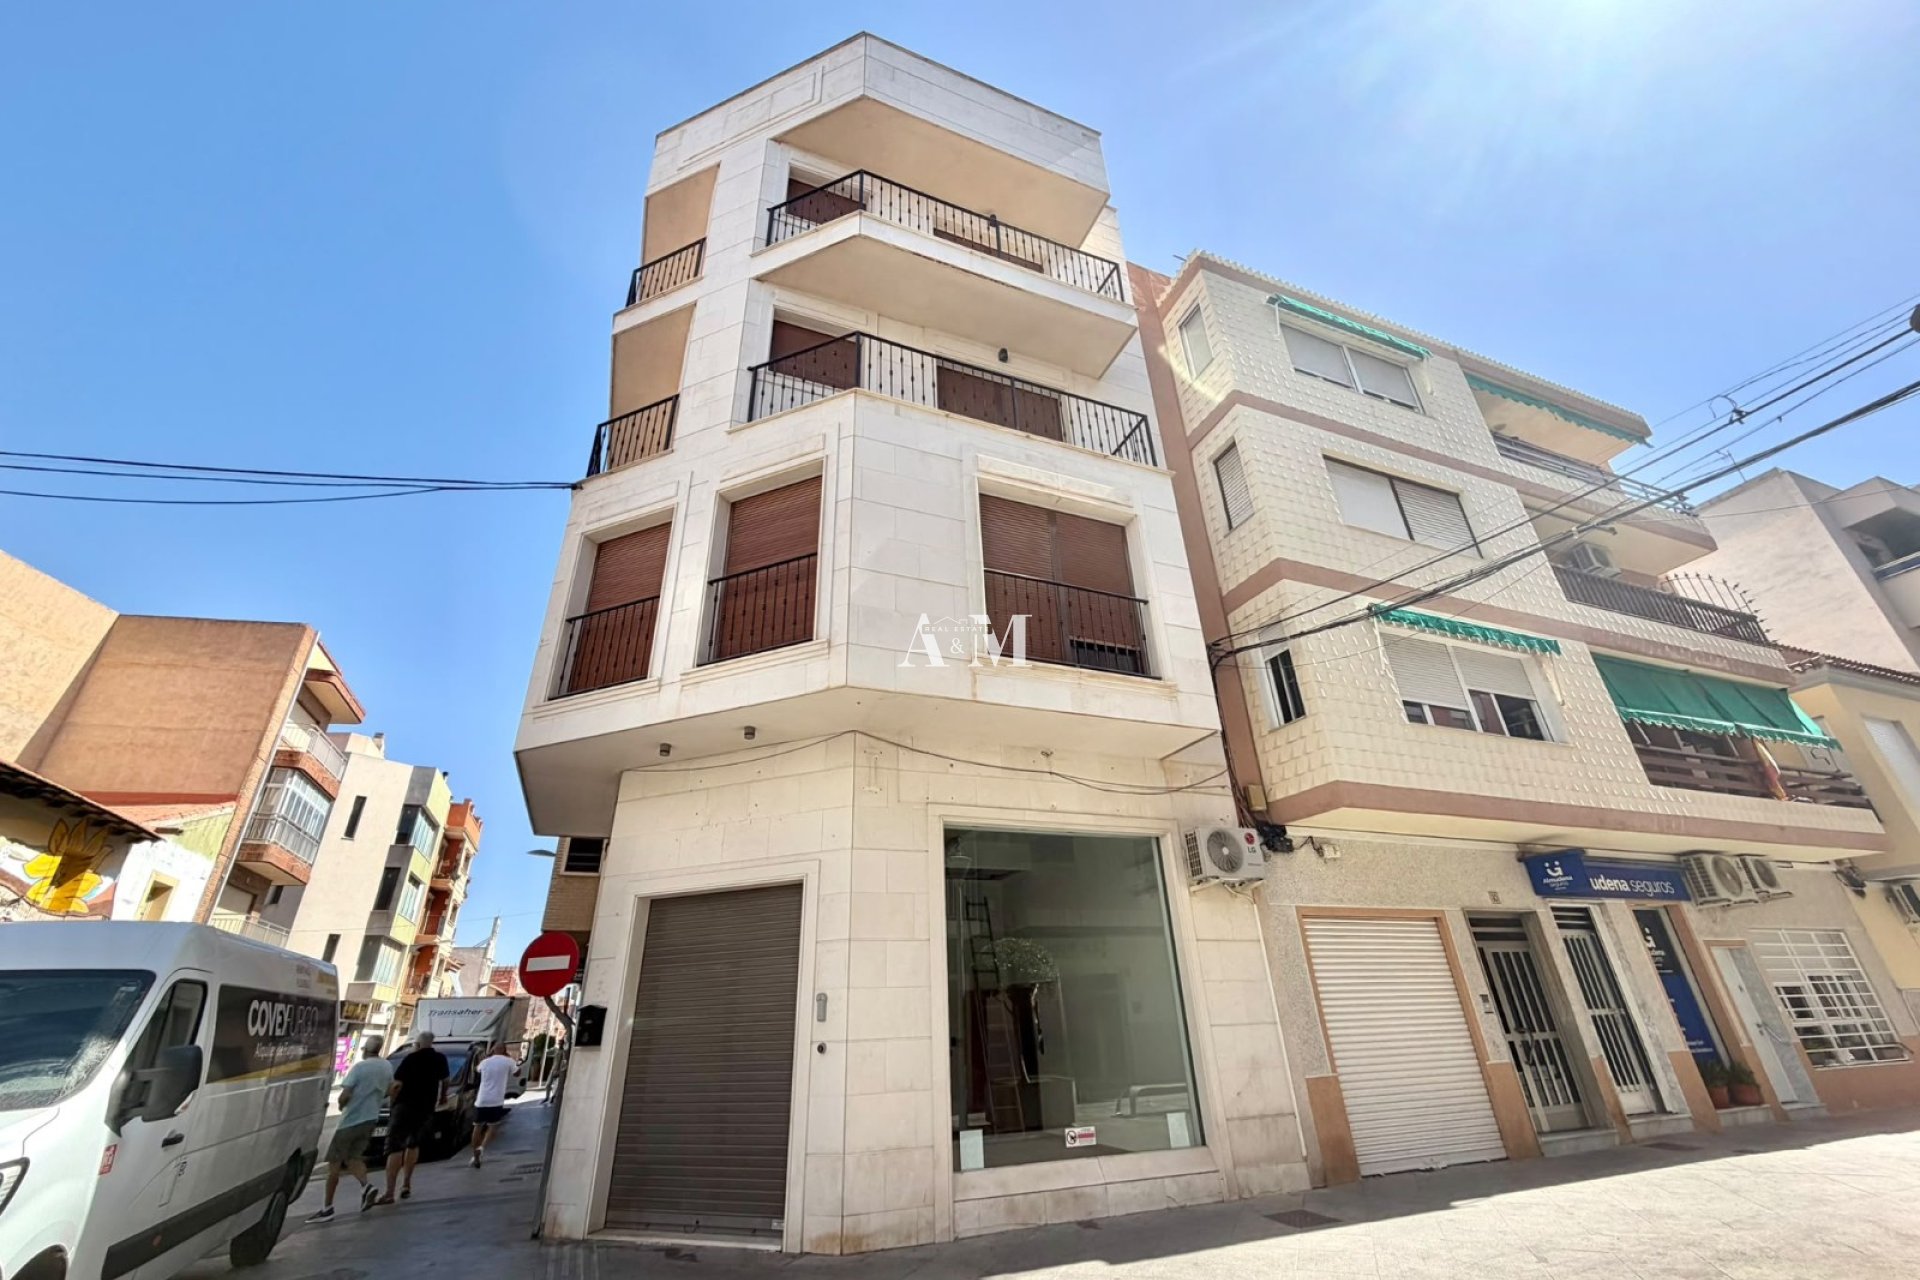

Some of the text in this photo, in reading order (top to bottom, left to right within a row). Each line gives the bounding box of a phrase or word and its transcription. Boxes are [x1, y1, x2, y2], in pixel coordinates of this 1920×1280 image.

[1247, 846, 1256, 854] LG
[1590, 874, 1675, 896] udena seguros
[428, 1008, 484, 1017] Transaher
